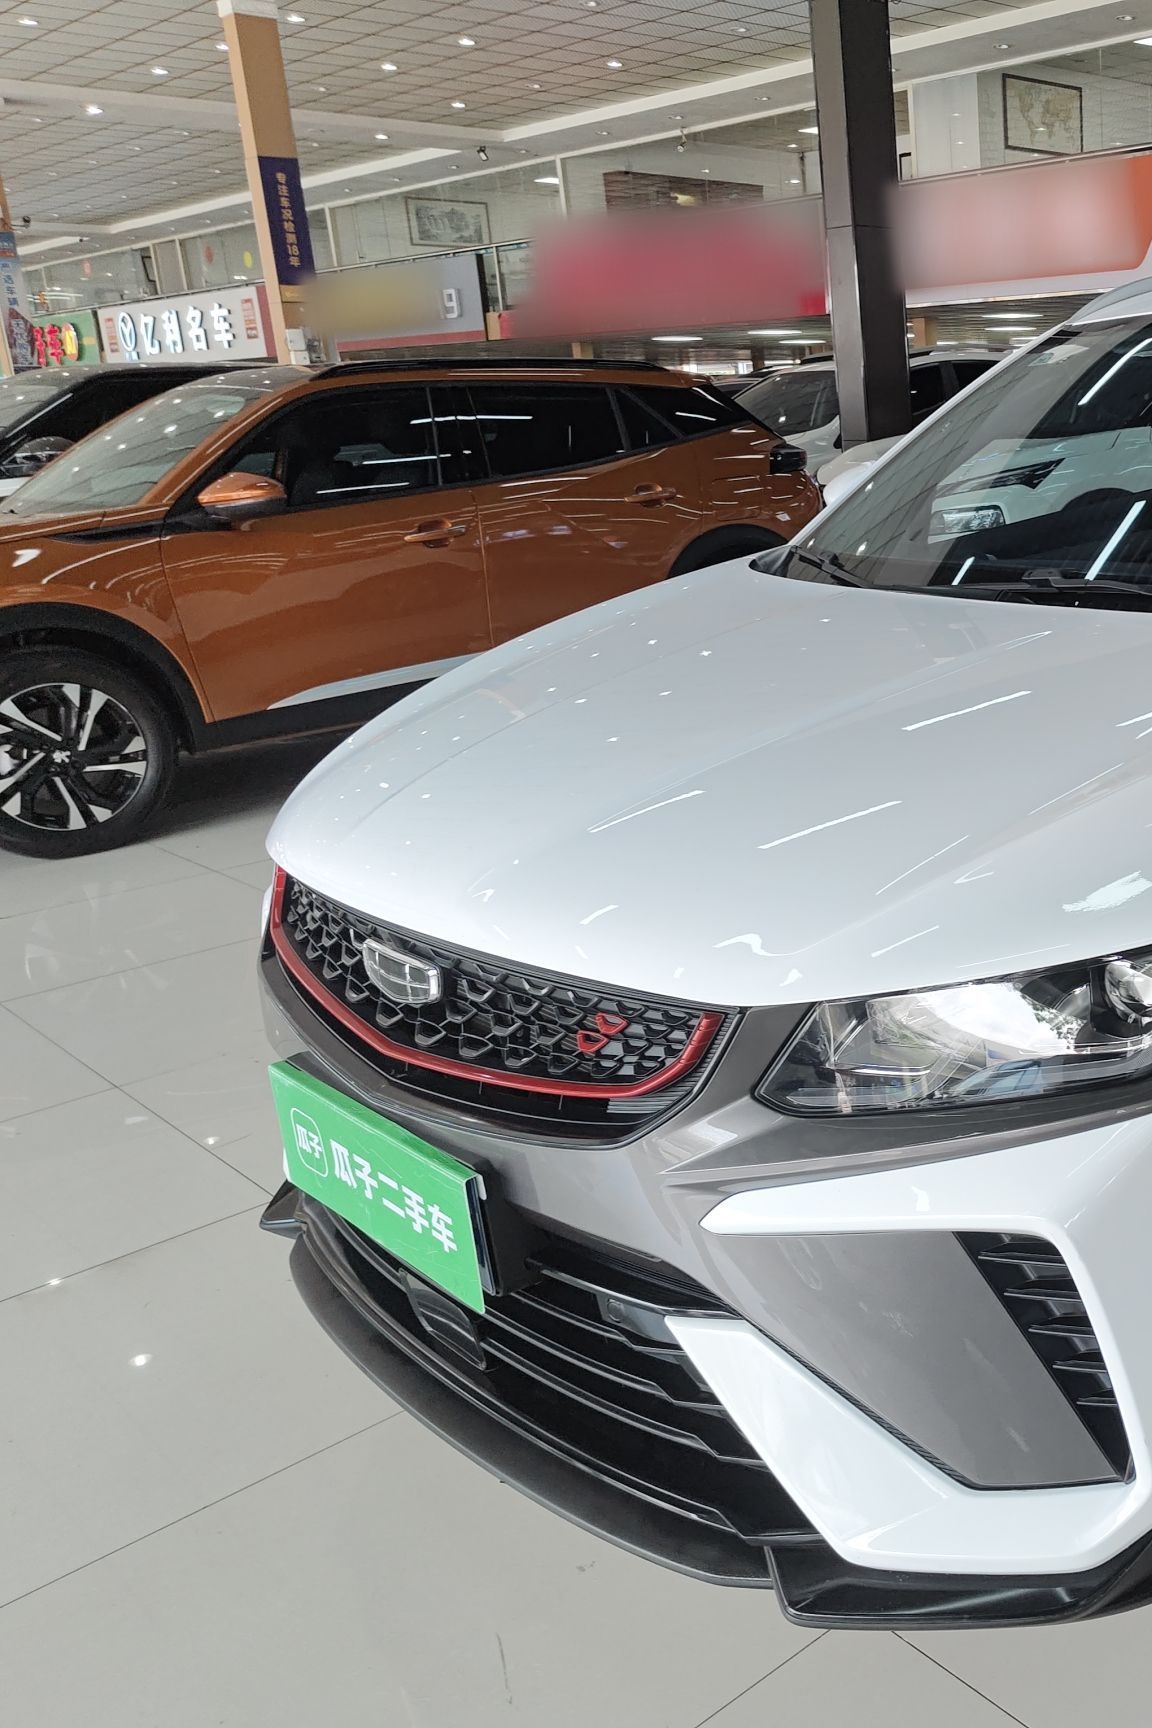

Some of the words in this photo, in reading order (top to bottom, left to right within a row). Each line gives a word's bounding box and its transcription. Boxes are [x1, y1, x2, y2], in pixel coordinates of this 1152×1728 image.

[140, 302, 236, 356] 亿利名车
[296, 1123, 322, 1160] 瓜子
[330, 1138, 458, 1254] 瓜子二手车
